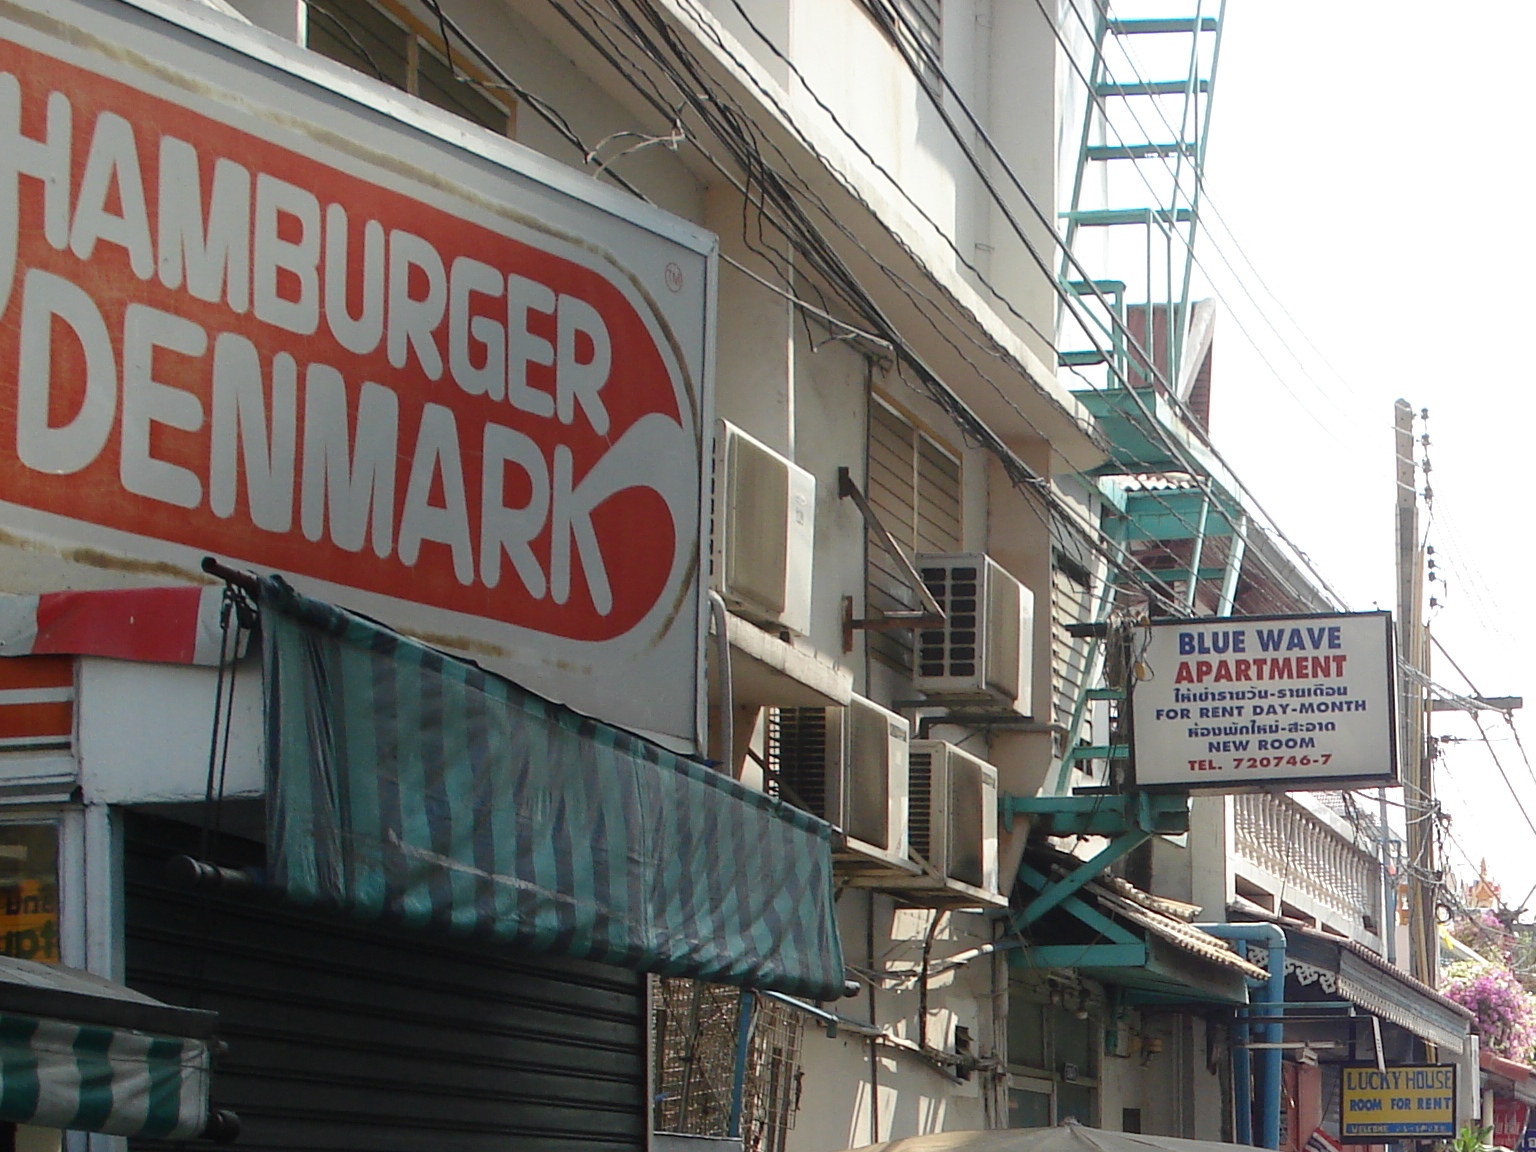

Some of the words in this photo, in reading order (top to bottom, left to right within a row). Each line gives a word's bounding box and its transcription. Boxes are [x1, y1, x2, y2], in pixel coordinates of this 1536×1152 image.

[0, 70, 612, 437] HAMBURGER
[17, 267, 685, 617] DENMARK
[1179, 630, 1246, 656] BLUE
[1256, 626, 1342, 651] WAVE
[1174, 655, 1347, 684] APARTMENT
[1156, 708, 1191, 720] FOR
[1199, 704, 1245, 719] RENT
[1252, 700, 1367, 717] DAY-MONTH
[1208, 740, 1251, 753] NEW
[1258, 736, 1316, 751] ROOM
[1188, 758, 1223, 771] TEL.
[1233, 753, 1332, 769] 720746-7
[1347, 1070, 1401, 1090] LUCKY
[1405, 1070, 1452, 1089] HOUSE
[1349, 1098, 1382, 1111] ROOM
[1390, 1098, 1412, 1110] FOR
[1417, 1097, 1452, 1110] RENT
